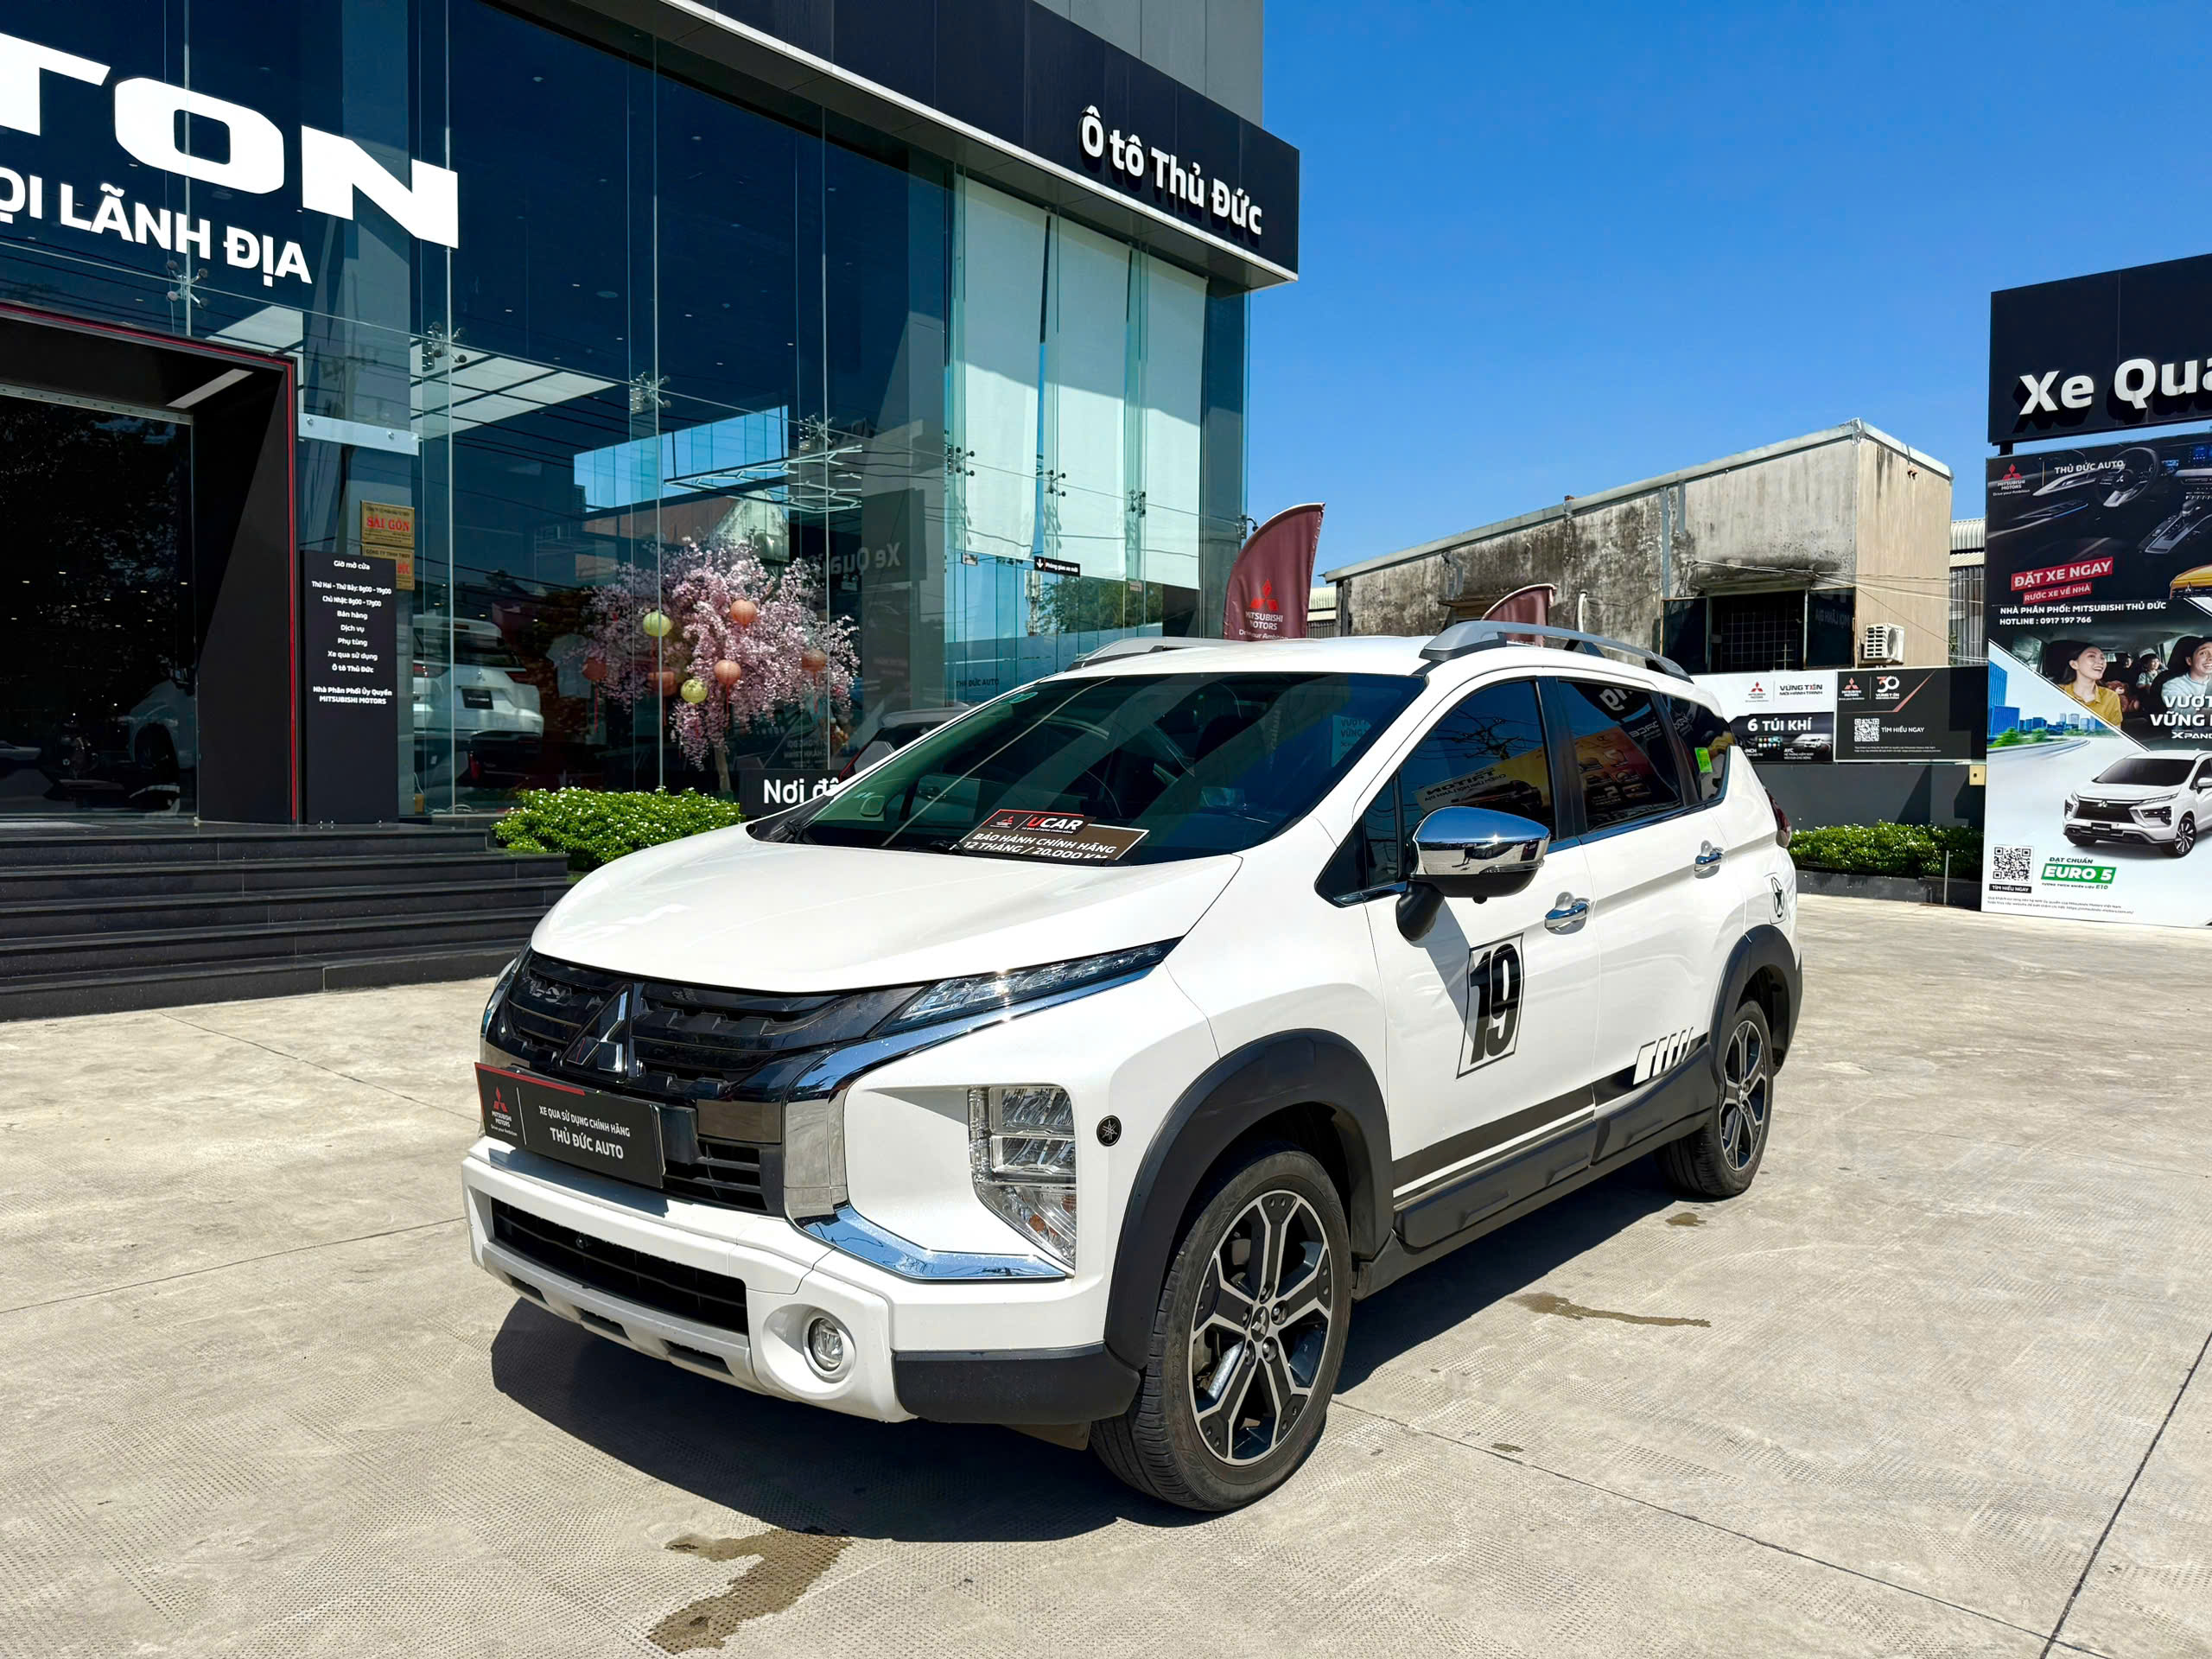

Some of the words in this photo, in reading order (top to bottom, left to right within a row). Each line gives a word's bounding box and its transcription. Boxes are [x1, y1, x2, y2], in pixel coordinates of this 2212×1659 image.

[1081, 105, 1103, 158] Ô
[1109, 130, 1144, 177] tô
[1150, 147, 1205, 208] Thủ
[1211, 178, 1262, 236] Đức
[60, 182, 212, 259] LÃNH
[223, 226, 313, 288] ĐỊA
[2018, 370, 2094, 416] Xe
[2114, 358, 2212, 410] Qu
[2054, 463, 2075, 474] THỦ
[2075, 461, 2095, 472] ĐỨC
[2098, 460, 2124, 469] AUTO
[2014, 572, 2044, 588] ĐẶT
[2046, 569, 2065, 582] XE
[2069, 561, 2112, 578] NGAY
[2048, 588, 2058, 597] XE
[2072, 583, 2091, 594] NHÀ
[2000, 605, 2019, 614] NHÀ
[2020, 604, 2045, 614] PHÂN
[2072, 603, 2125, 613] MITSUBISHI
[2126, 601, 2145, 611] THỦ
[2146, 600, 2166, 610] ĐỨC
[1250, 620, 1278, 630] OTORS
[1877, 676, 1900, 693] 30
[1747, 718, 1758, 732] 6
[1762, 717, 1784, 732] TÚI
[1788, 716, 1813, 731] KHÍ
[2150, 710, 2205, 727] VỮNG
[763, 779, 804, 804] Nơi
[1027, 817, 1084, 830] UCAR
[963, 841, 978, 849] 12
[979, 842, 1024, 853] THÁNG
[1032, 847, 1083, 859] 20.000
[972, 831, 1001, 842] BẢO
[1001, 832, 1037, 845] HÀNH
[1036, 837, 1077, 849] CHÍNH
[1076, 842, 1117, 855] HÃNG
[2044, 865, 2096, 880] EURO
[2100, 868, 2113, 881] 5
[1470, 943, 1521, 1065] 19
[539, 1105, 548, 1116] XE
[548, 1108, 561, 1120] QUA
[562, 1109, 570, 1122] SỬ
[571, 1115, 588, 1127] DỤNG
[589, 1116, 610, 1133] CHÍNH
[610, 1123, 630, 1137] HÃNG
[550, 1126, 570, 1145] THỦ
[572, 1132, 594, 1152] ĐỨC
[595, 1140, 624, 1160] AUTO
